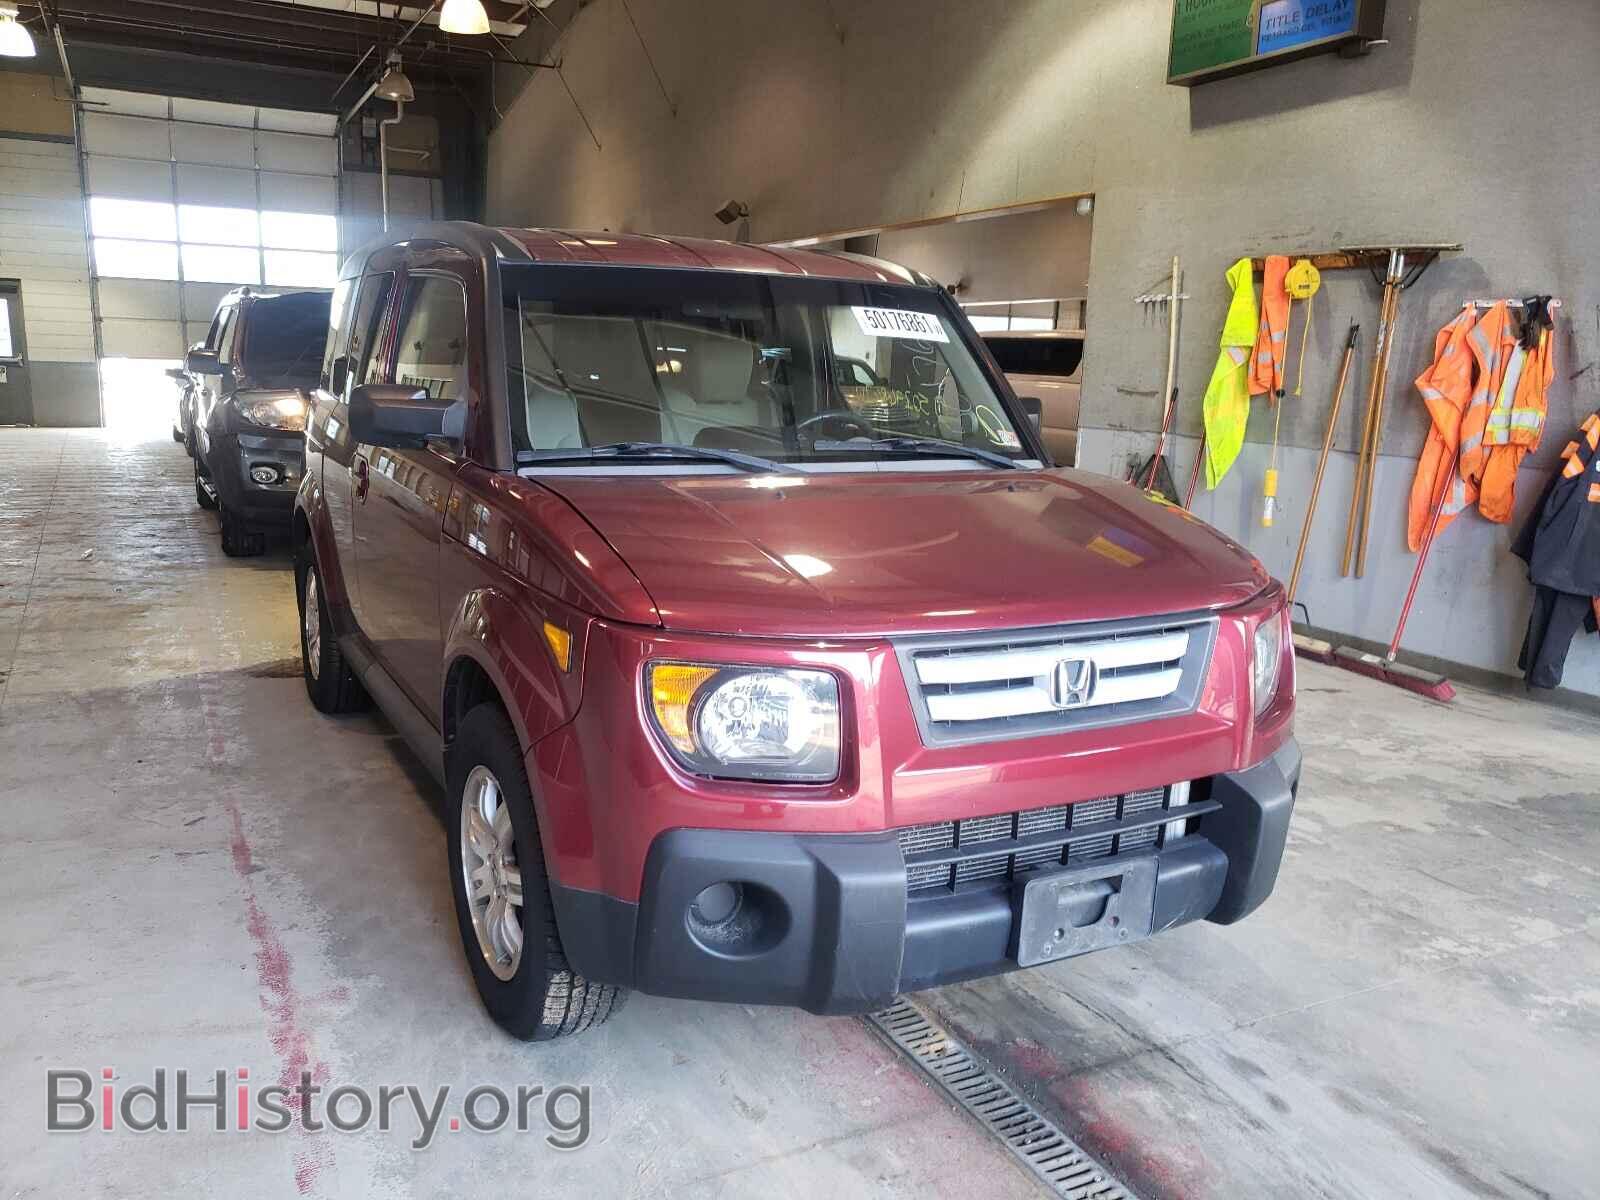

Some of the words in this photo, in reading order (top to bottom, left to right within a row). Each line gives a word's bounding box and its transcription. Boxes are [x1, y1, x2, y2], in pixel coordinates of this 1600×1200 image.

[1265, 10, 1300, 30] TITLE
[1305, 0, 1348, 19] DELAY
[863, 309, 933, 334] 50176861
